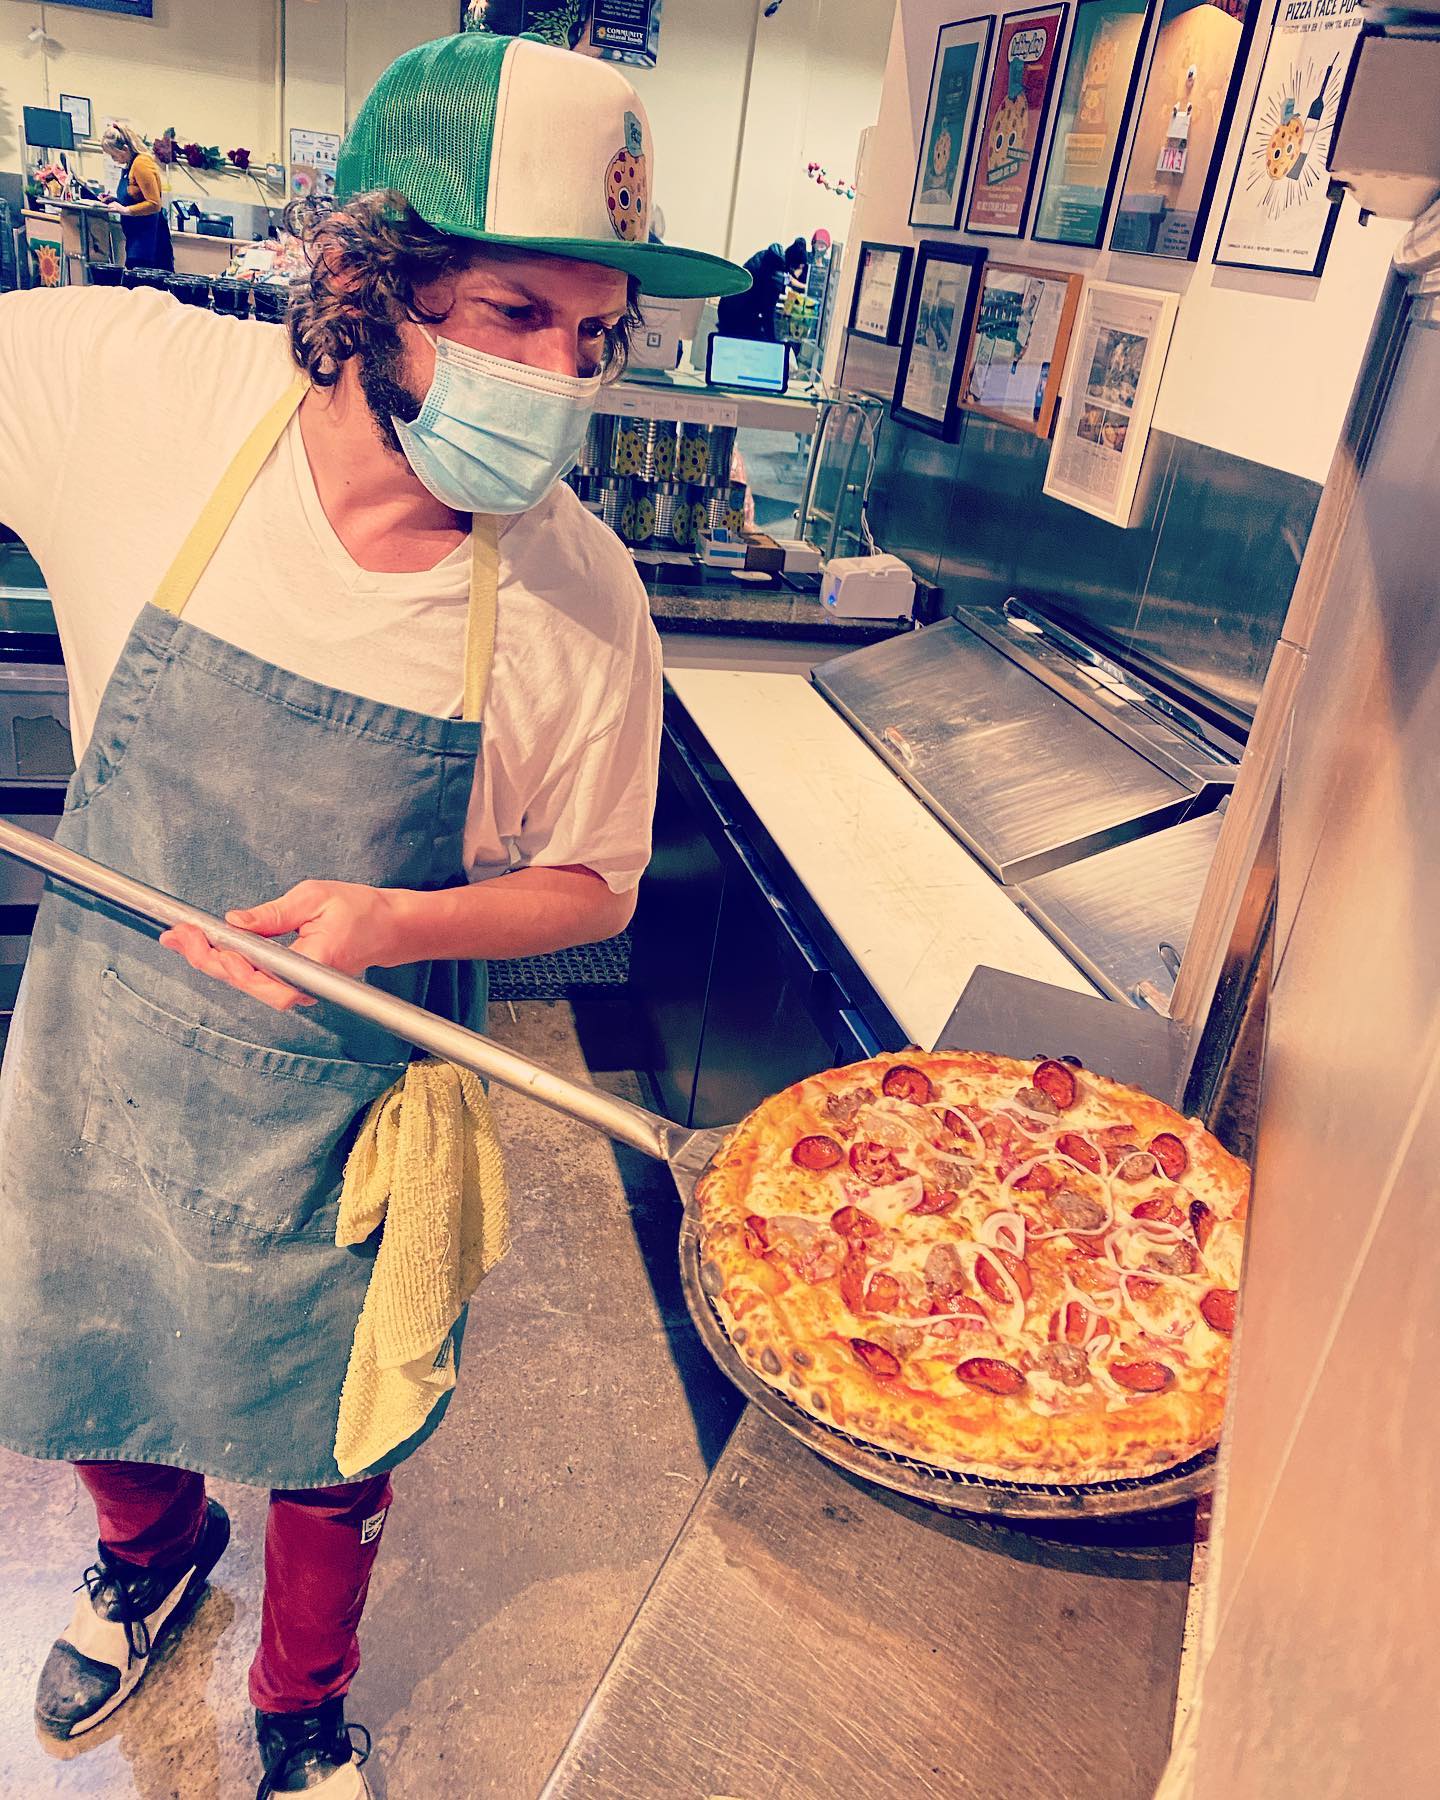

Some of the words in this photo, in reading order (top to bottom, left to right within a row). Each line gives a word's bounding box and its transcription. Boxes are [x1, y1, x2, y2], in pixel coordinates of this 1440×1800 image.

[1285, 1, 1312, 20] PIZZA
[1314, 0, 1337, 17] FACE
[607, 27, 644, 38] COMMUNITY
[628, 36, 643, 44] foods
